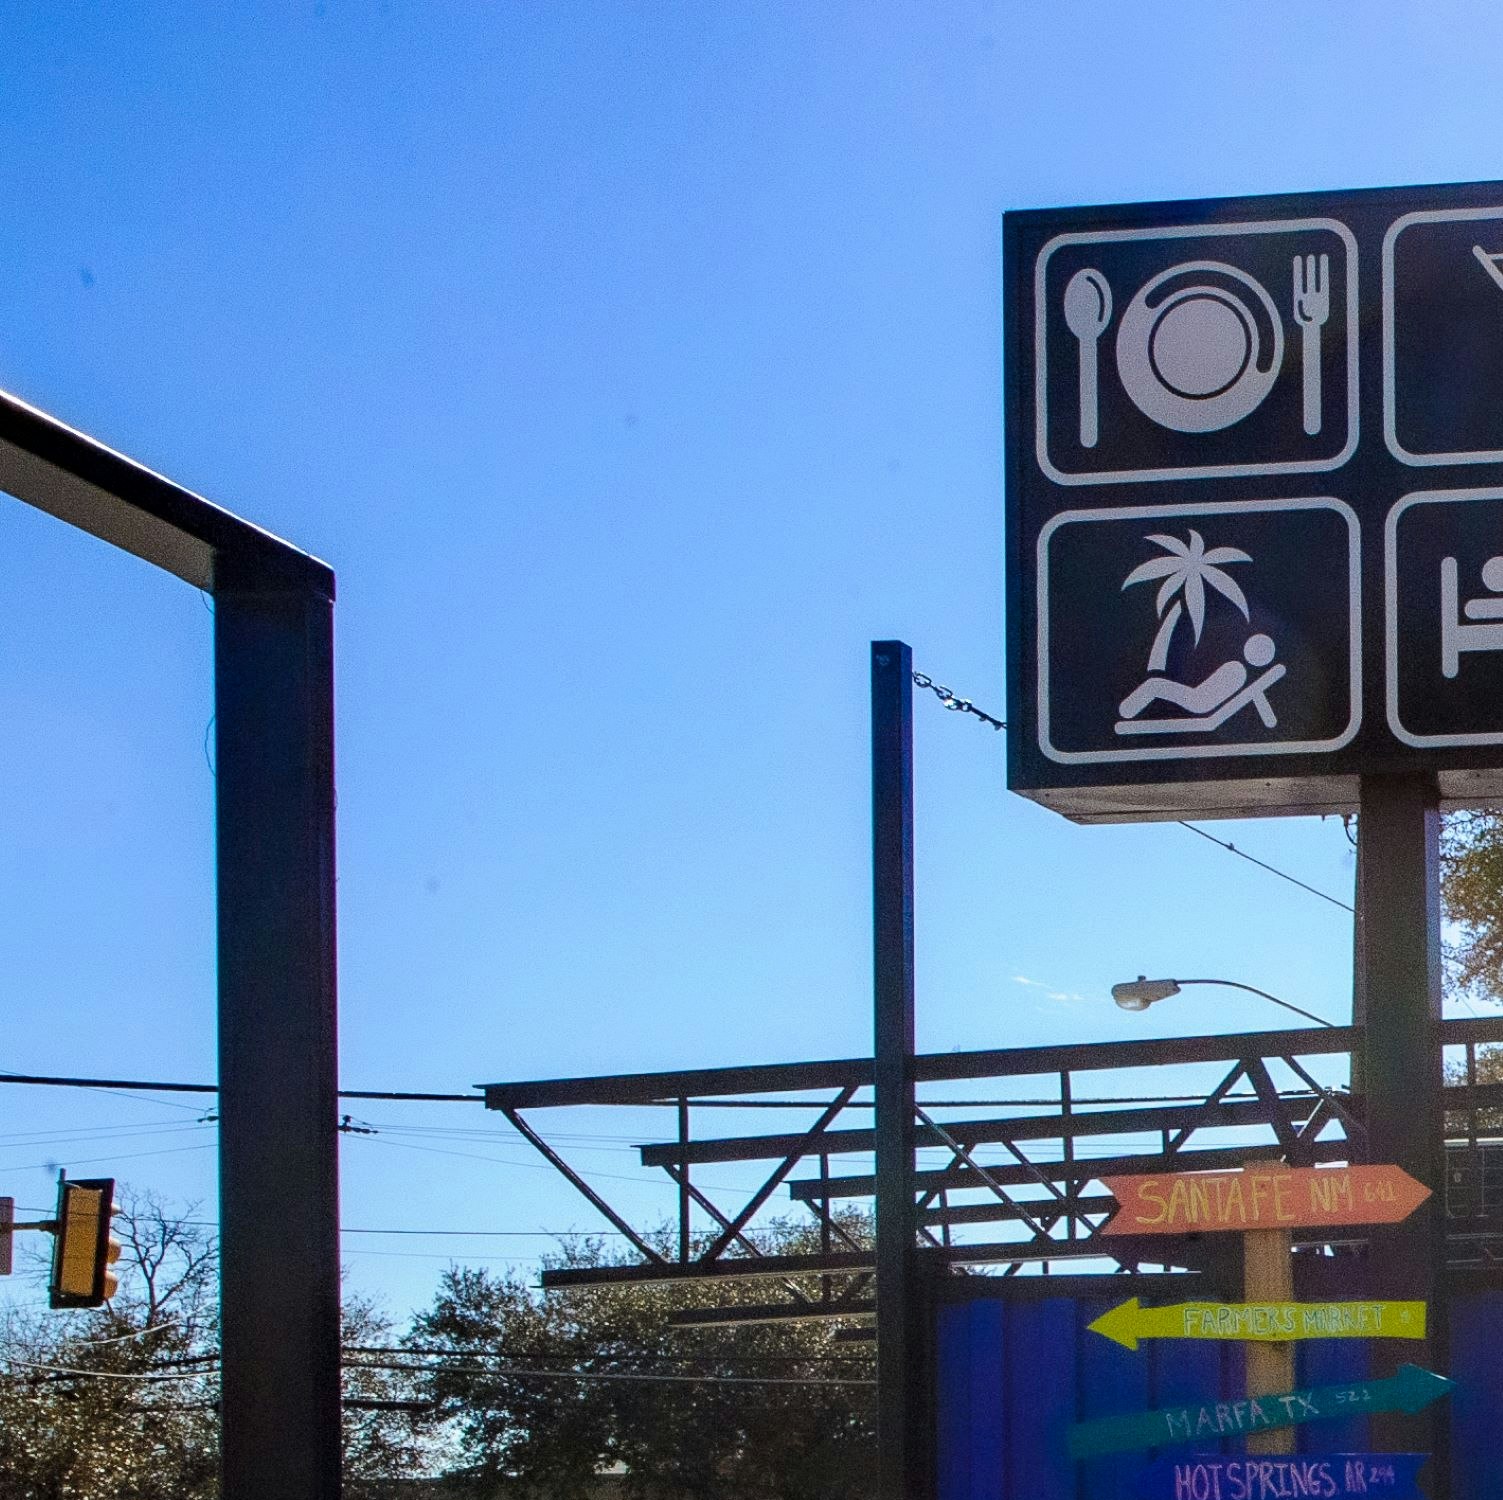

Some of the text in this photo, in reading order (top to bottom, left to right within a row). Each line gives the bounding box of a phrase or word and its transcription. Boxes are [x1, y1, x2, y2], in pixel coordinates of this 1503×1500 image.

[1309, 1174, 1352, 1212] NM
[1183, 1306, 1297, 1336] FARMERS
[1302, 1304, 1386, 1333] MARKET
[1164, 1399, 1270, 1438] MARFA
[1278, 1391, 1320, 1419] TX
